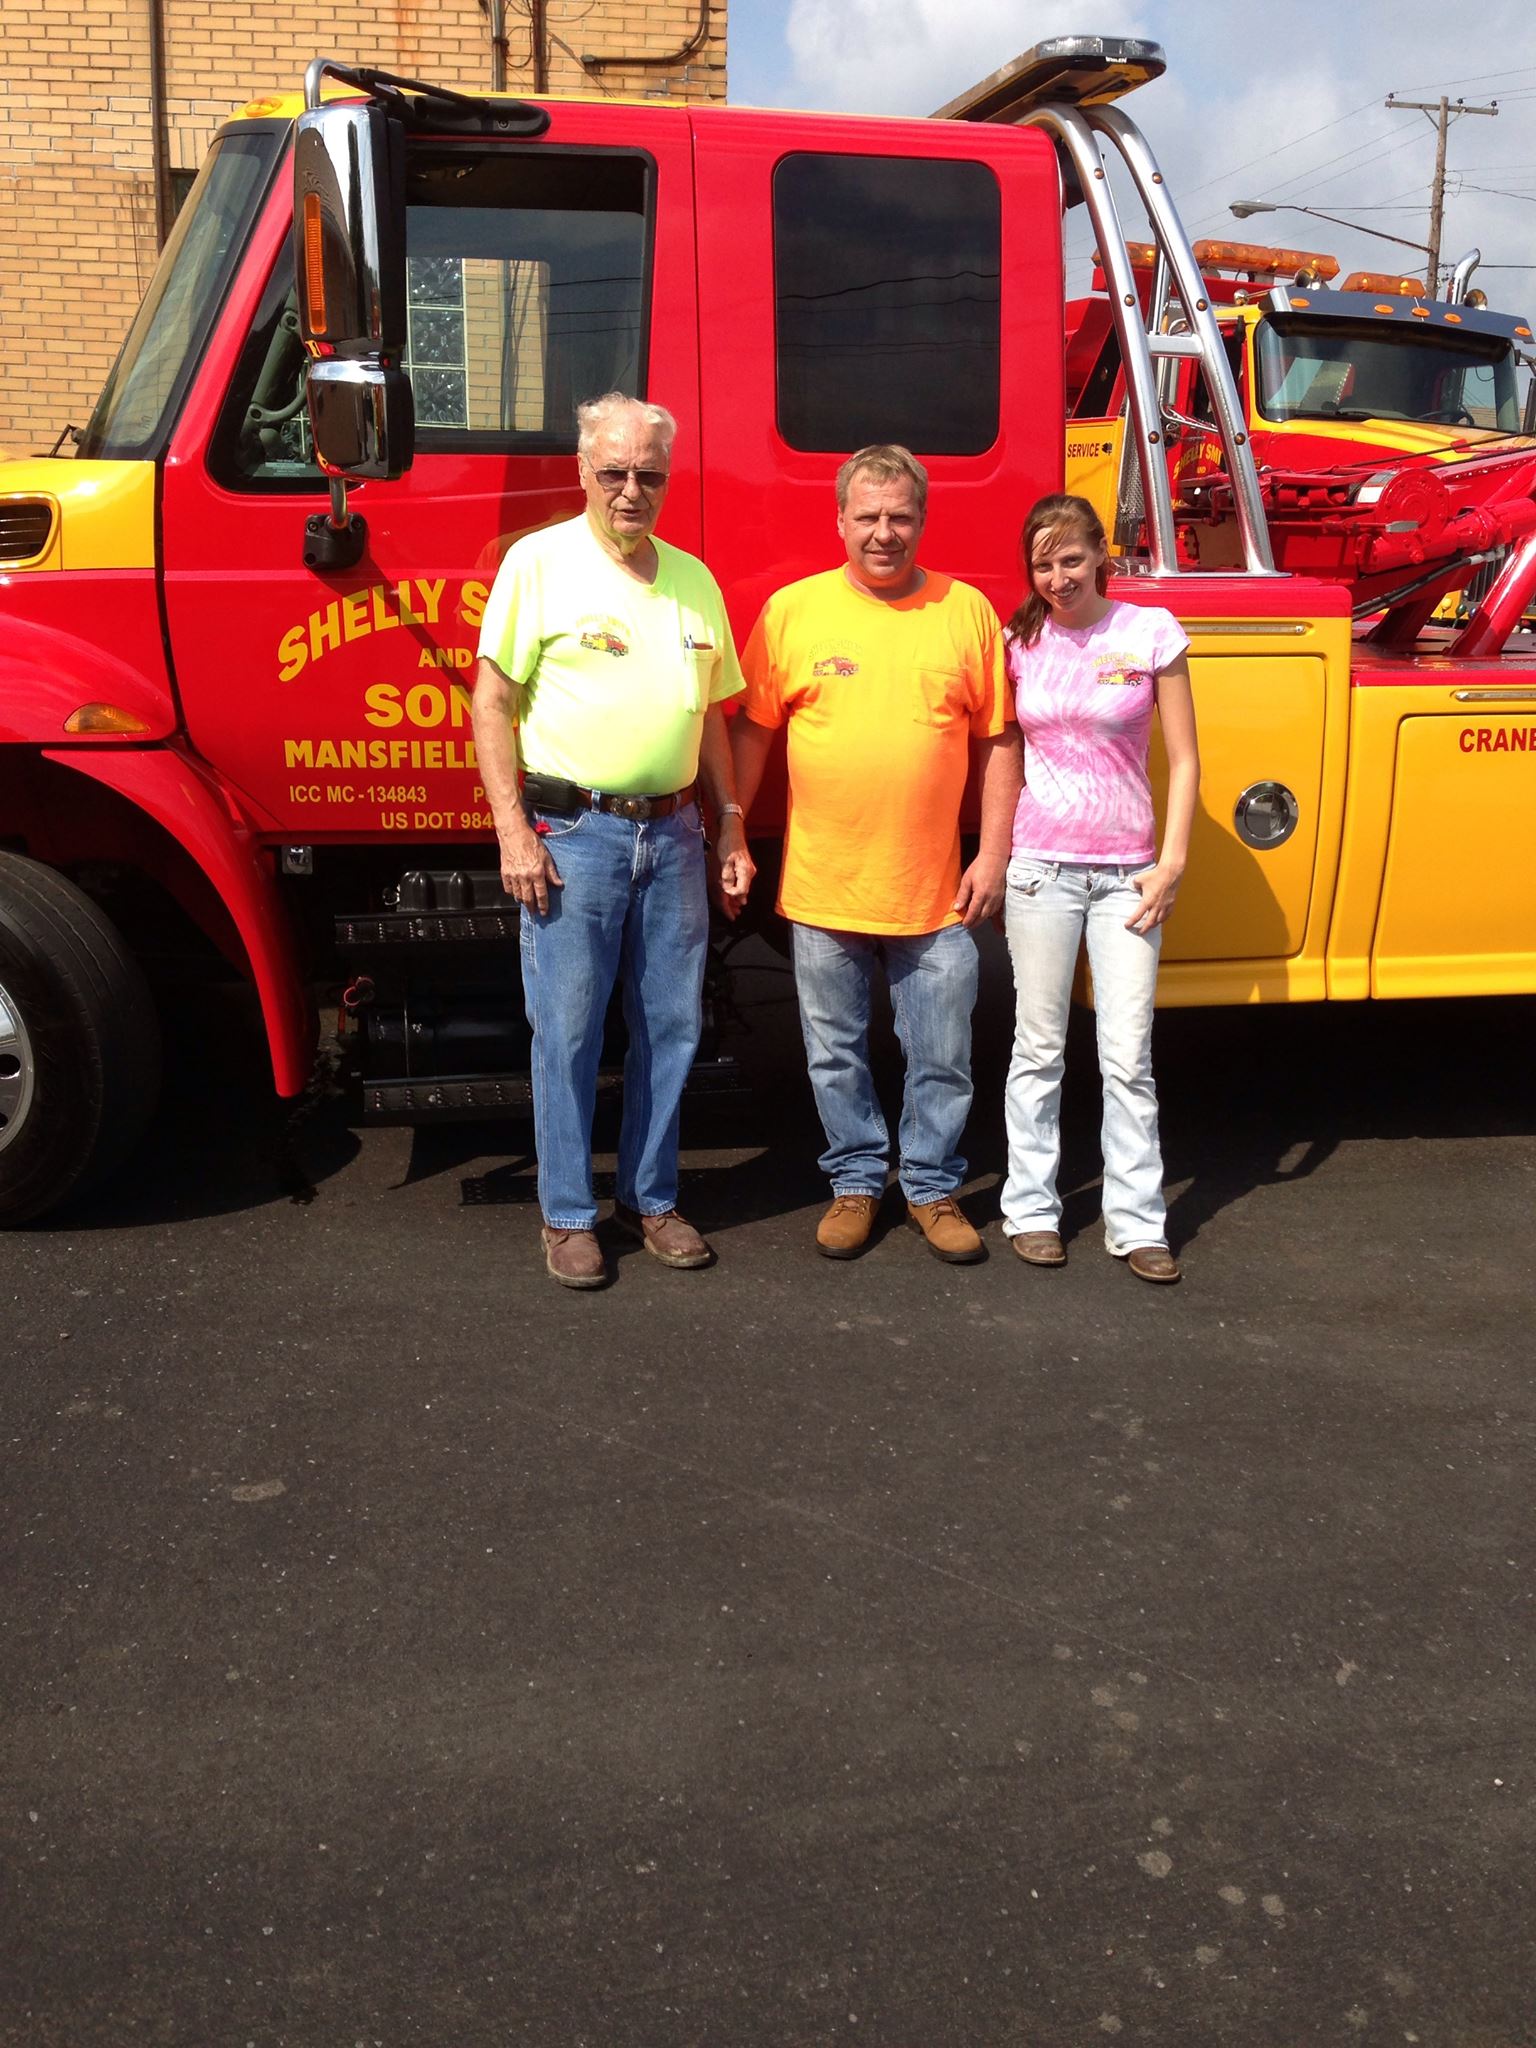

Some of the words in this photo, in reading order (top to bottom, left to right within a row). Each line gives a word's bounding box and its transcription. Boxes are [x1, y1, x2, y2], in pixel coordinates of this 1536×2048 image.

[1067, 442, 1100, 458] SERVICE
[278, 579, 447, 683] SHELLY
[418, 648, 473, 668] AND
[289, 786, 322, 804] ICC
[382, 812, 409, 830] US
[414, 812, 456, 830] DOT
[460, 812, 495, 830] 984
